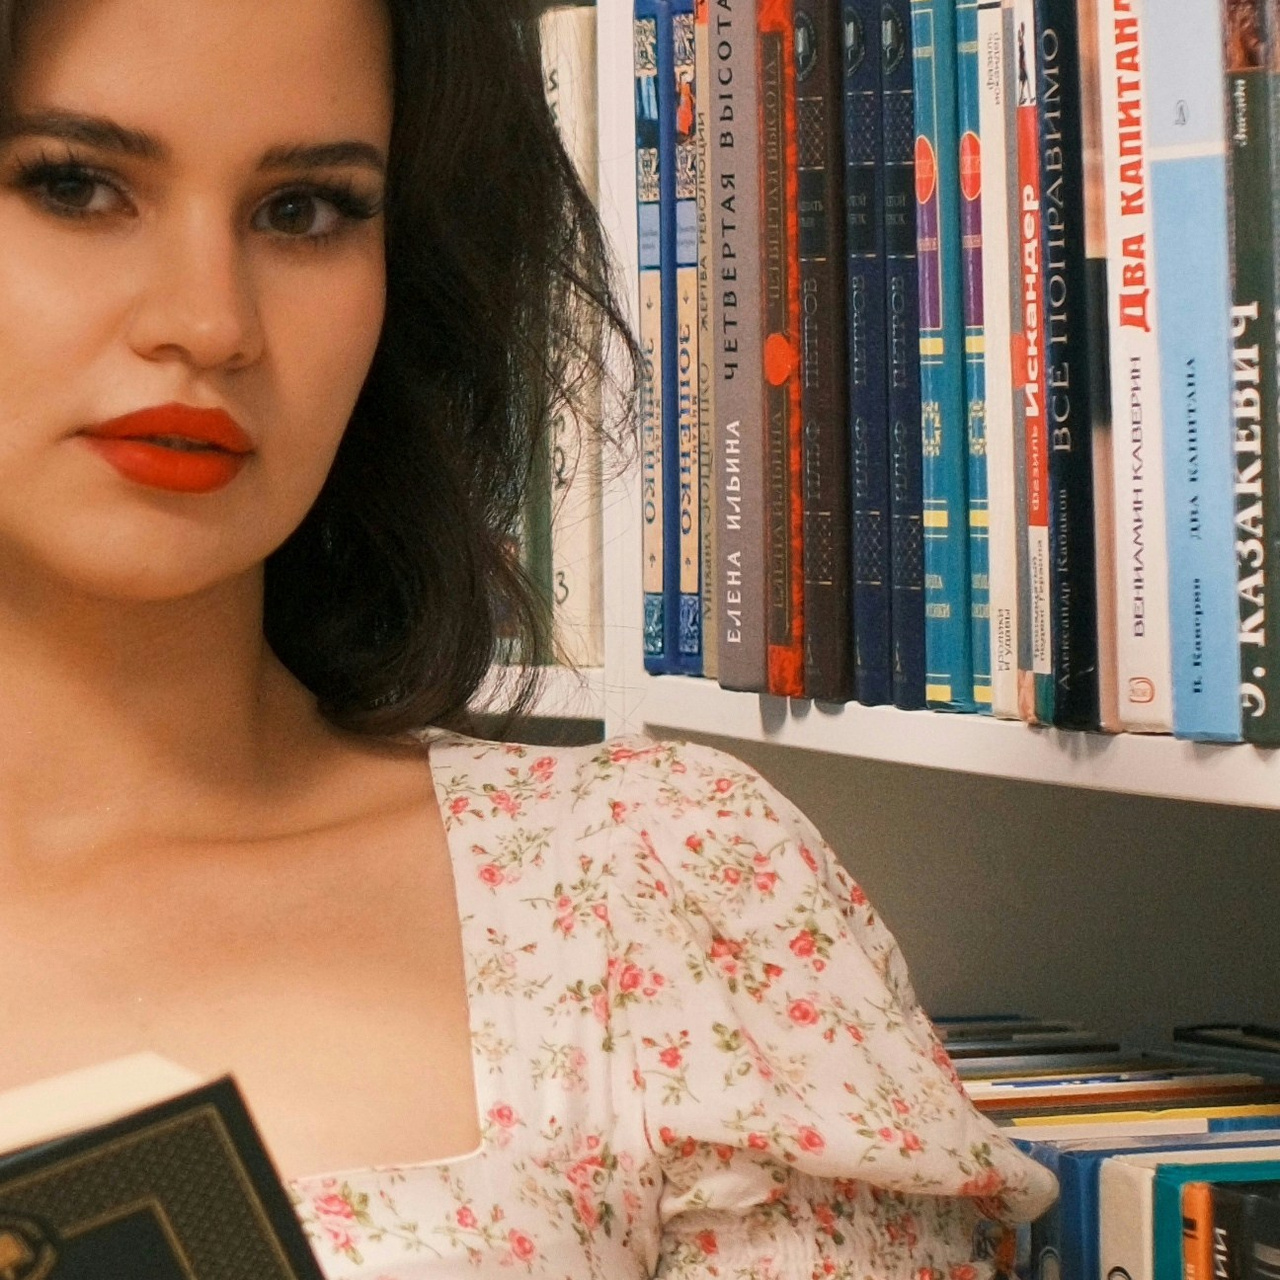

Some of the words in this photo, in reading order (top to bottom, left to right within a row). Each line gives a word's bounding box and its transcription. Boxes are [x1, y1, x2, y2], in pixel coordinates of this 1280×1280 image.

[765, 59, 780, 162] ВЫСОТА
[696, 111, 709, 245] РЕВОЛЮЦИИ
[1040, 26, 1069, 345] ПОПРАВИМО
[699, 256, 709, 332] ЖЕРТВА
[719, 172, 739, 380] ЧЕТВЕРТАЯ
[852, 275, 868, 385] ПЕТРОВ
[891, 275, 907, 388] ПЕТРОВ
[1022, 184, 1040, 418] Искандер
[1119, 233, 1151, 334] ДВА
[803, 276, 819, 389] ПЕТРОВ
[677, 323, 693, 536] ЗОЩЕНКО
[1050, 362, 1071, 452] ВСЁ
[1129, 355, 1144, 481] КАВЕРИН
[1186, 357, 1200, 483] КАПИТАНА
[724, 419, 742, 530] ИЛЬИНА
[1188, 495, 1201, 540] ДВА
[1230, 301, 1266, 647] КАЗАКЕВИЧ
[1056, 488, 1070, 572] Кабаков
[1131, 488, 1145, 638] ВЕНИАМИН
[726, 551, 742, 644] ЕЛЕНА
[1058, 581, 1072, 691] Александр
[1192, 578, 1204, 668] Каверин
[1236, 666, 1266, 719] Э.
